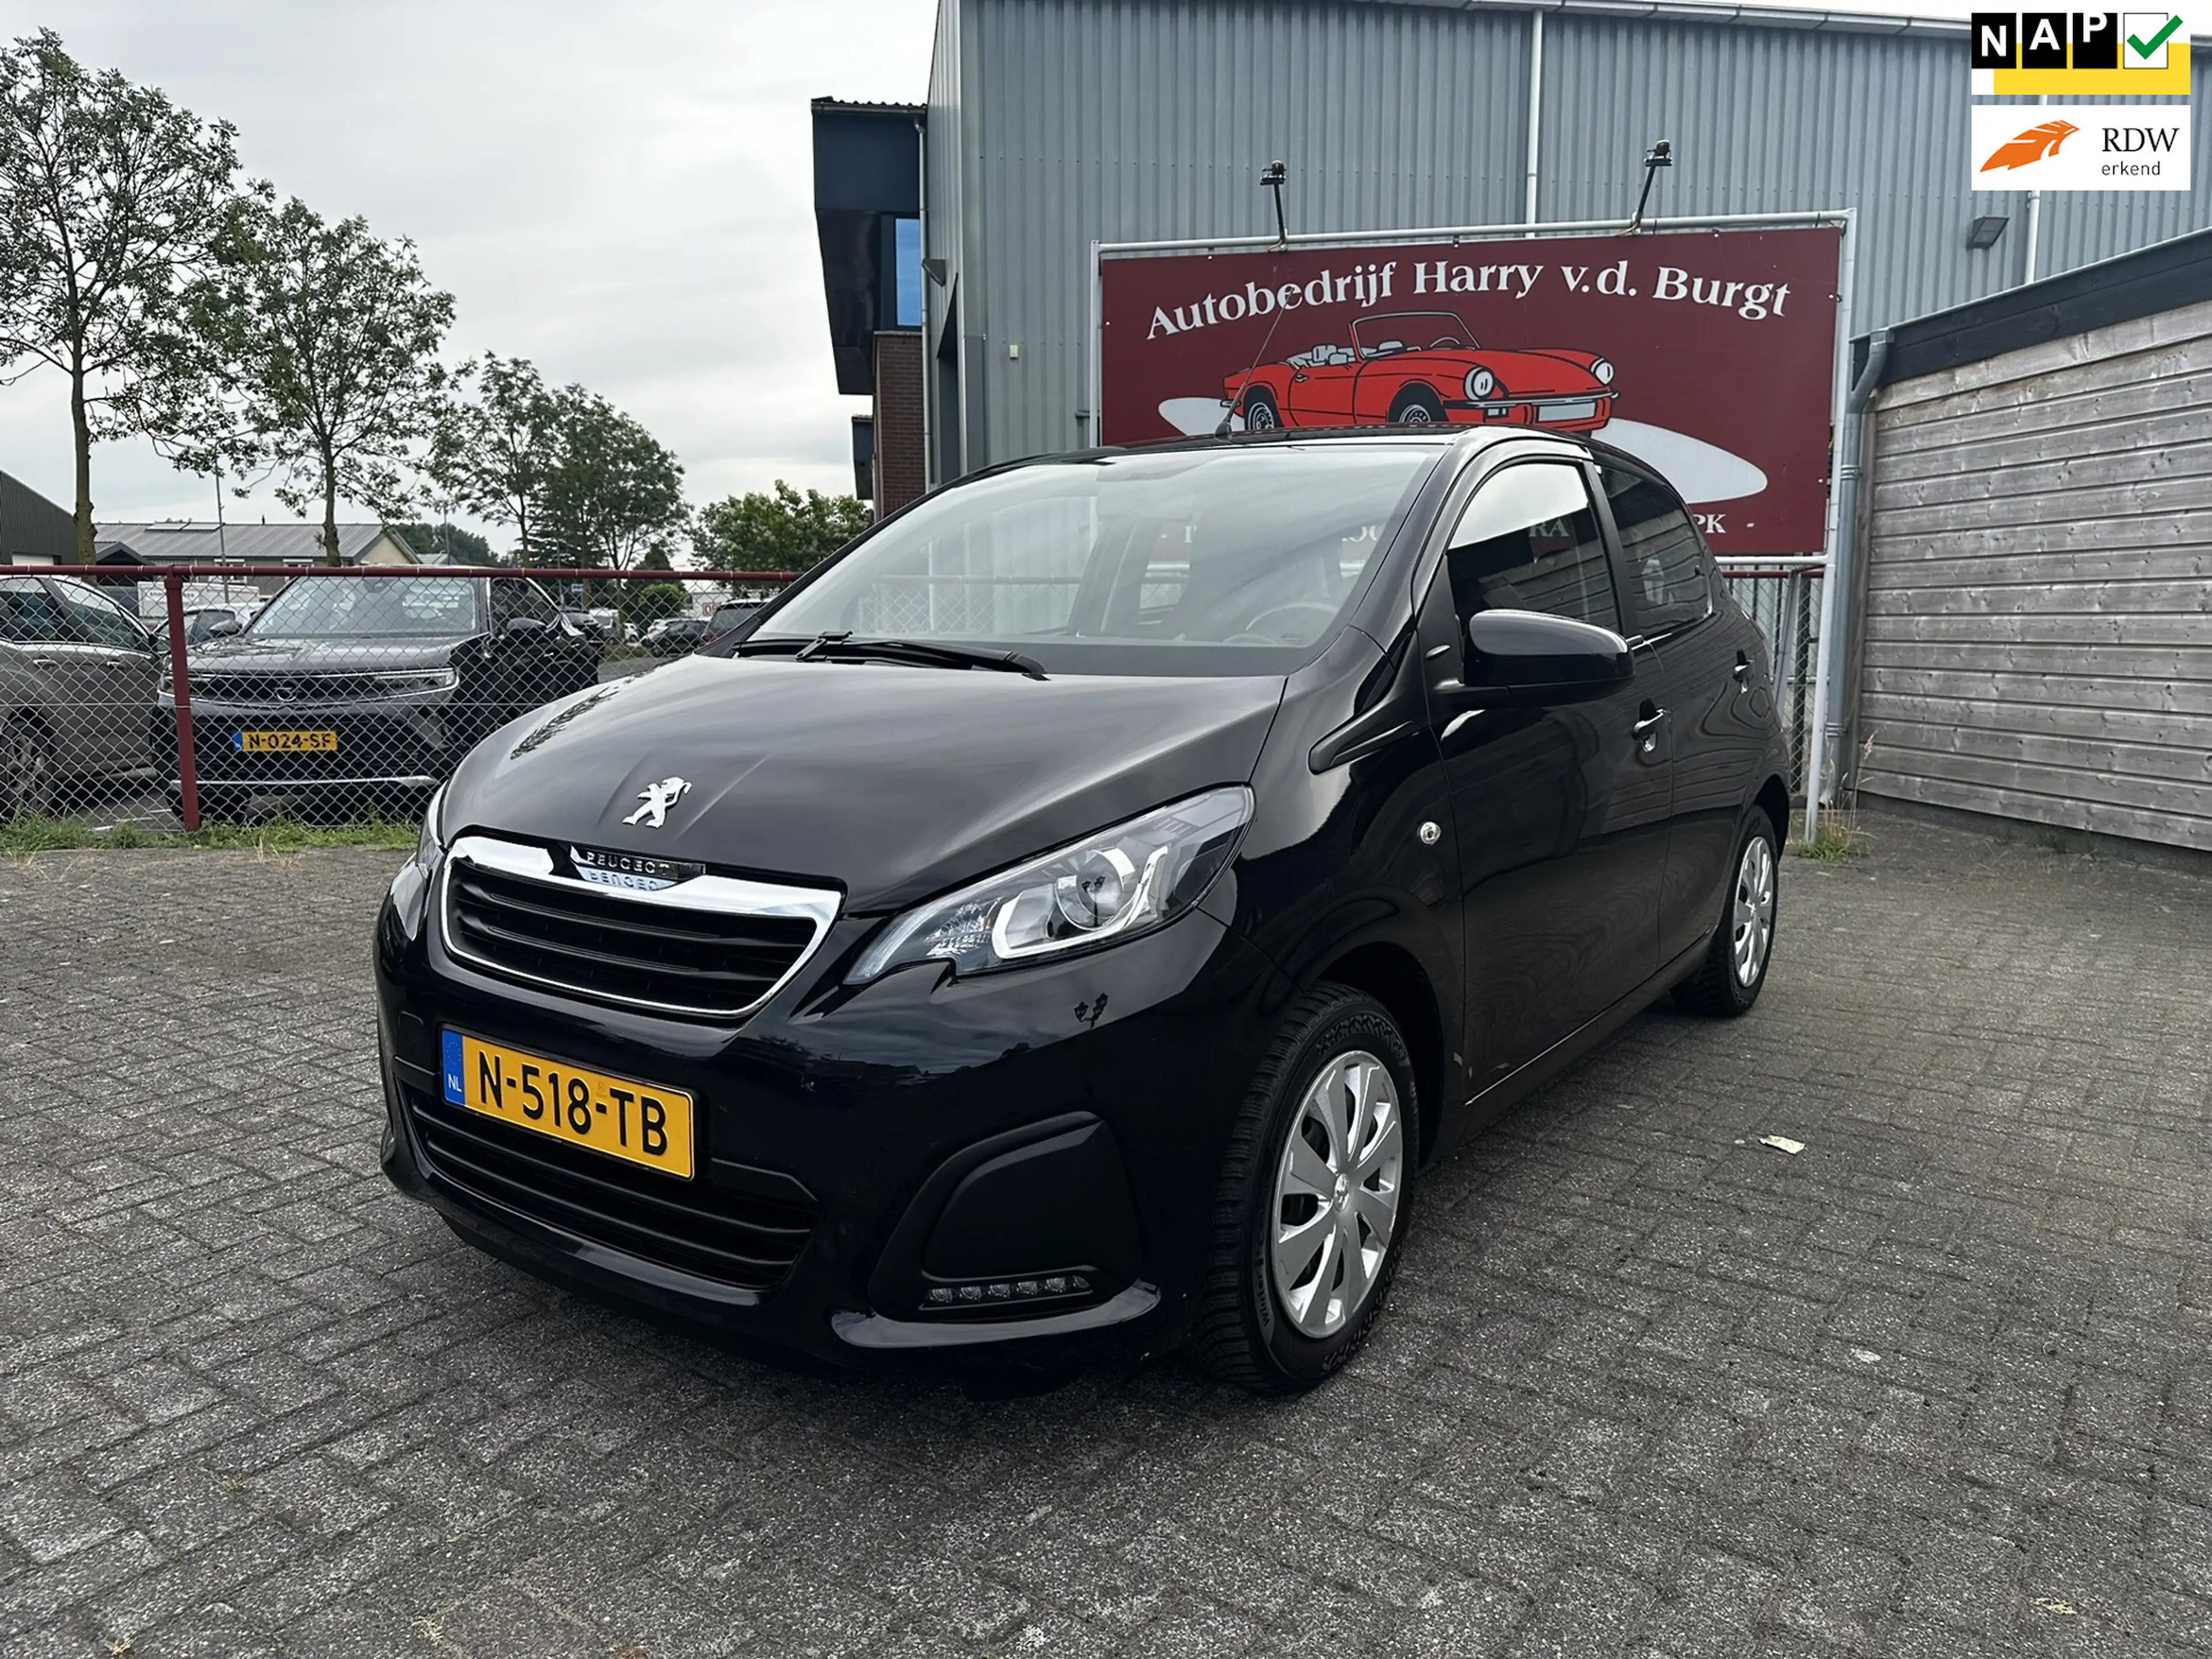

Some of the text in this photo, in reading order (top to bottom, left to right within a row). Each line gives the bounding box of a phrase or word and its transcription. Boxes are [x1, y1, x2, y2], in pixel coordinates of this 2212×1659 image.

[1146, 259, 1791, 340] Autobedrijf Harry v.d. Burgt
[248, 733, 331, 749] N-024-SF
[586, 851, 670, 876] PEUGEOT
[448, 1073, 463, 1093] NL
[478, 1049, 668, 1157] N-518-TB
